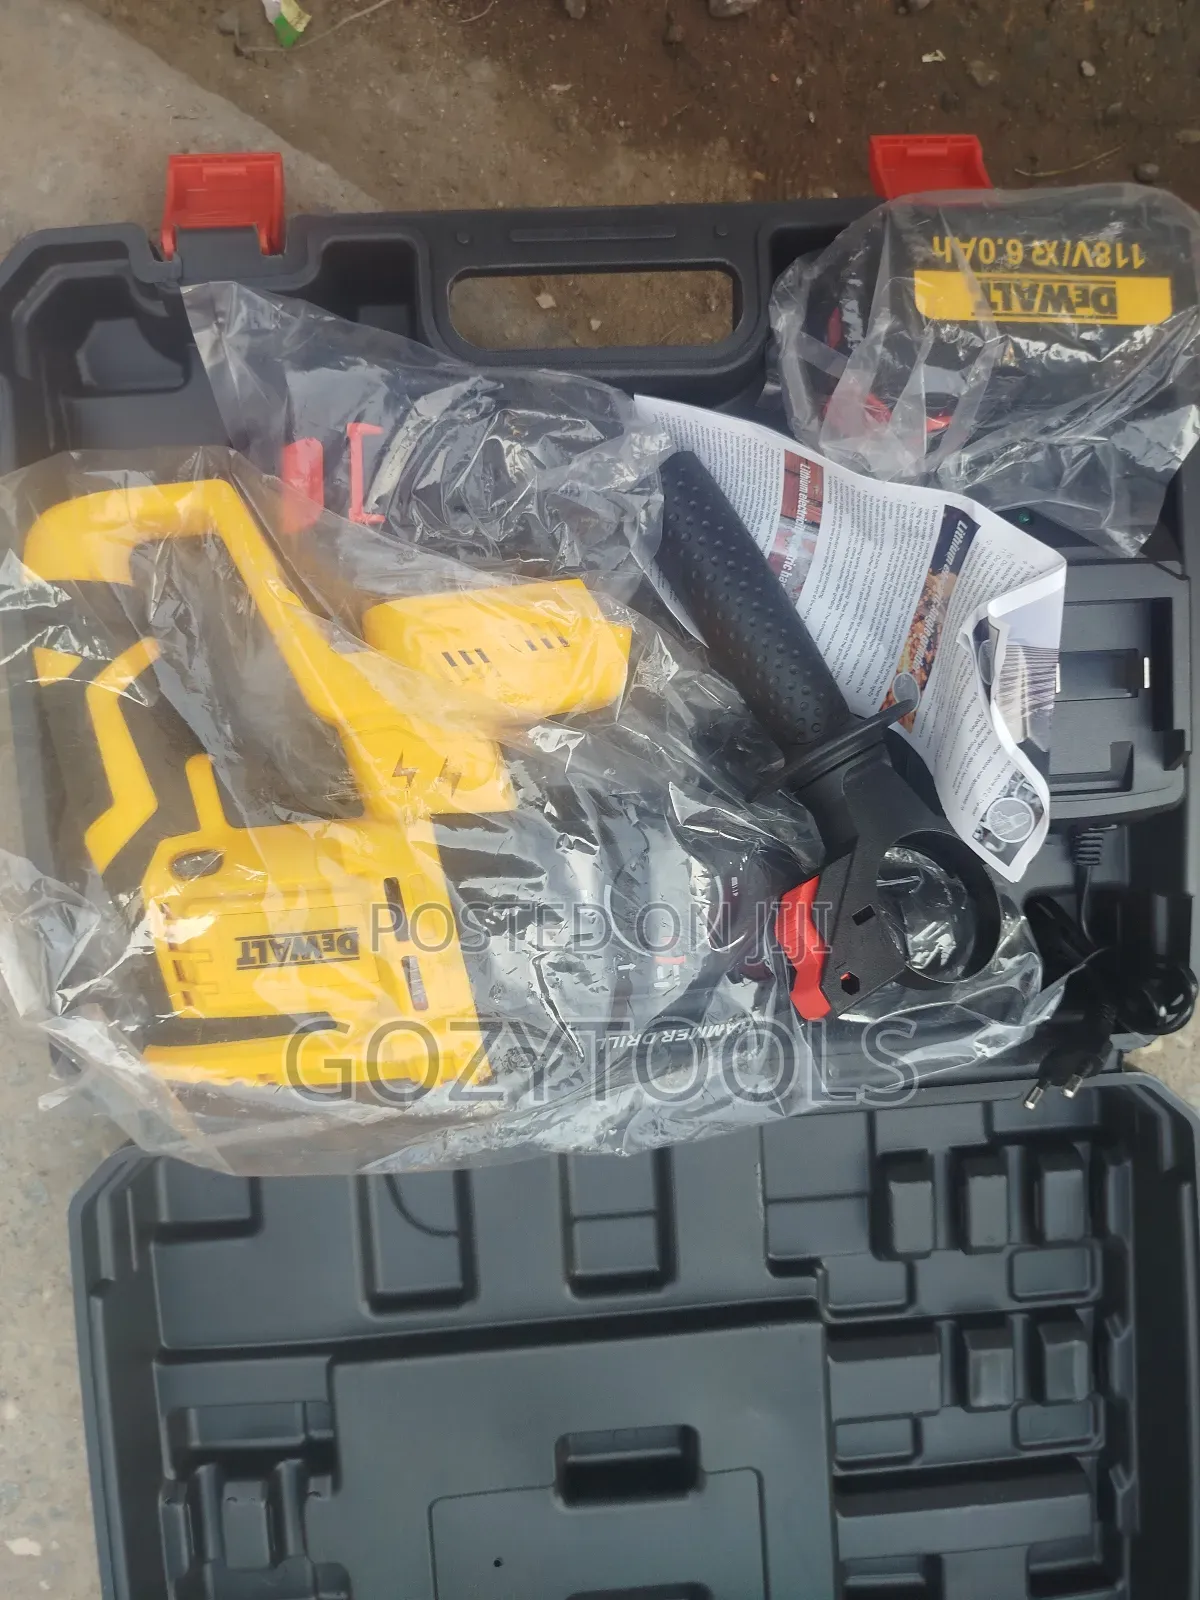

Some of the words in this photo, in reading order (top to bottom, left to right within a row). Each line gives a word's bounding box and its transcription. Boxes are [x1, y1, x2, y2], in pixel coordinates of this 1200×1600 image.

[932, 235, 1024, 266] 6.0Ah
[973, 278, 1118, 318] DEWALT
[798, 463, 811, 493] Lithium
[945, 519, 968, 565] Lithium
[235, 928, 360, 969] DEWALT
